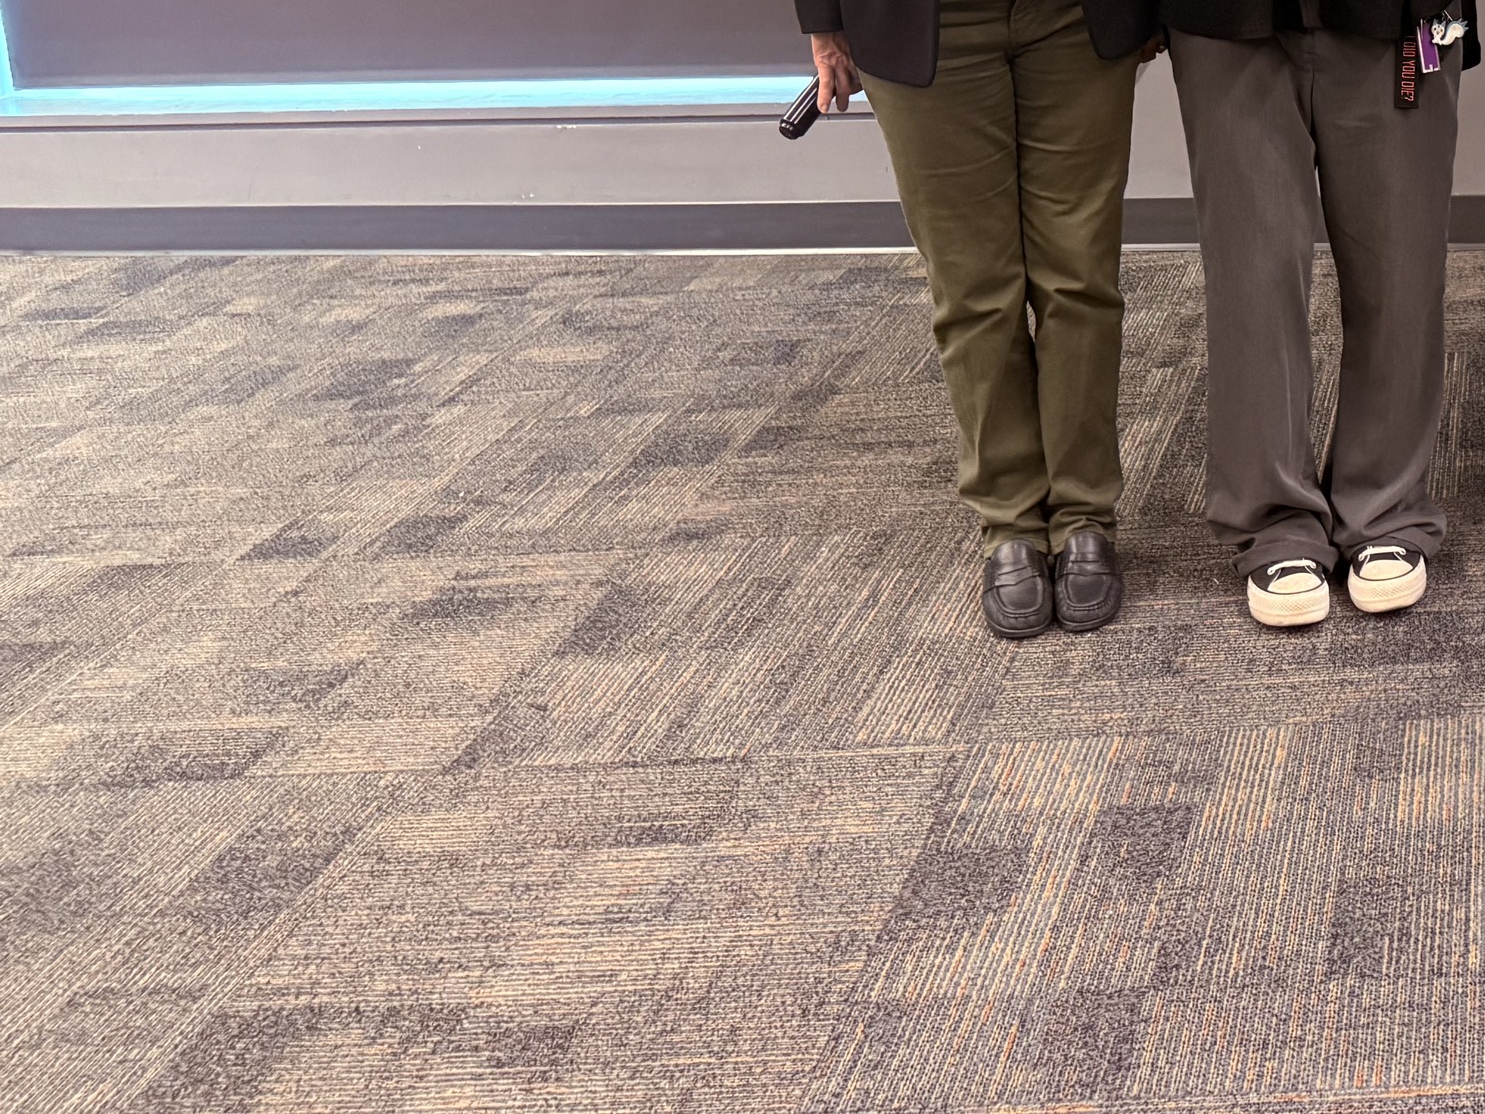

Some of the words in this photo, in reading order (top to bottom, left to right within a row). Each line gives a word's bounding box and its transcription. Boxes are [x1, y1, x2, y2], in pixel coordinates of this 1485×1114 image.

[1402, 41, 1416, 57] DID
[1401, 60, 1415, 79] YOU
[1400, 81, 1415, 102] DIE?
